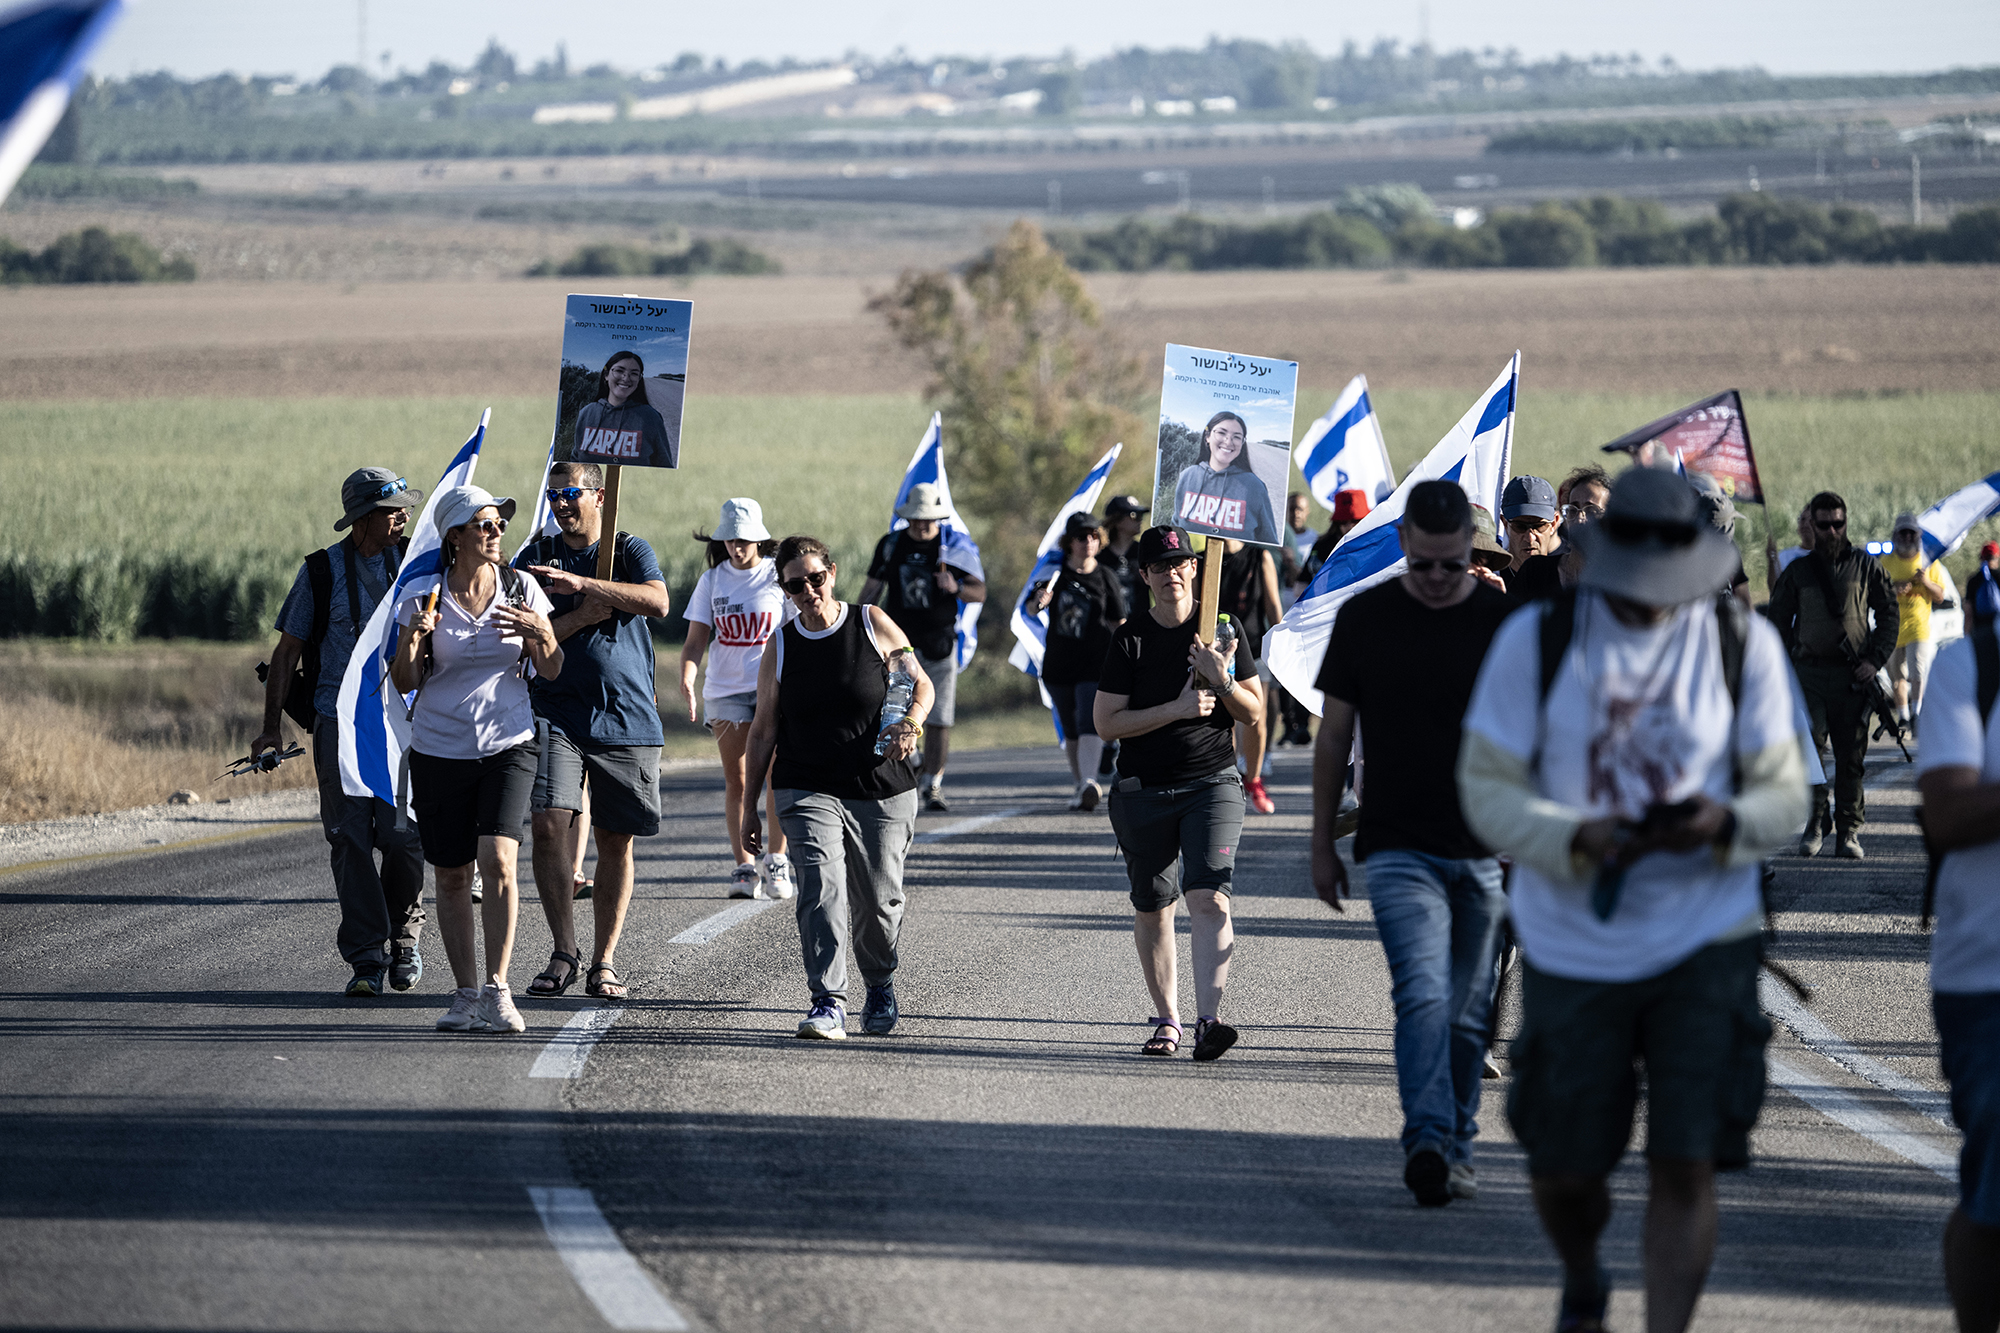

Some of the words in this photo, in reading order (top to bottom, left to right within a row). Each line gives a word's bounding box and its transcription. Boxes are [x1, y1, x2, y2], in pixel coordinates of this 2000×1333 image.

[590, 303, 643, 316] לייבושור
[647, 304, 668, 317] יעל
[1190, 355, 1246, 373] לייבושור
[1250, 362, 1272, 377] יעל
[1213, 391, 1240, 401] חברויות
[1258, 387, 1281, 396] אוהבת
[580, 427, 640, 458] MARVEL
[1180, 491, 1245, 530] MARVEL
[727, 603, 744, 613] HOME
[715, 611, 772, 640] NOW!
